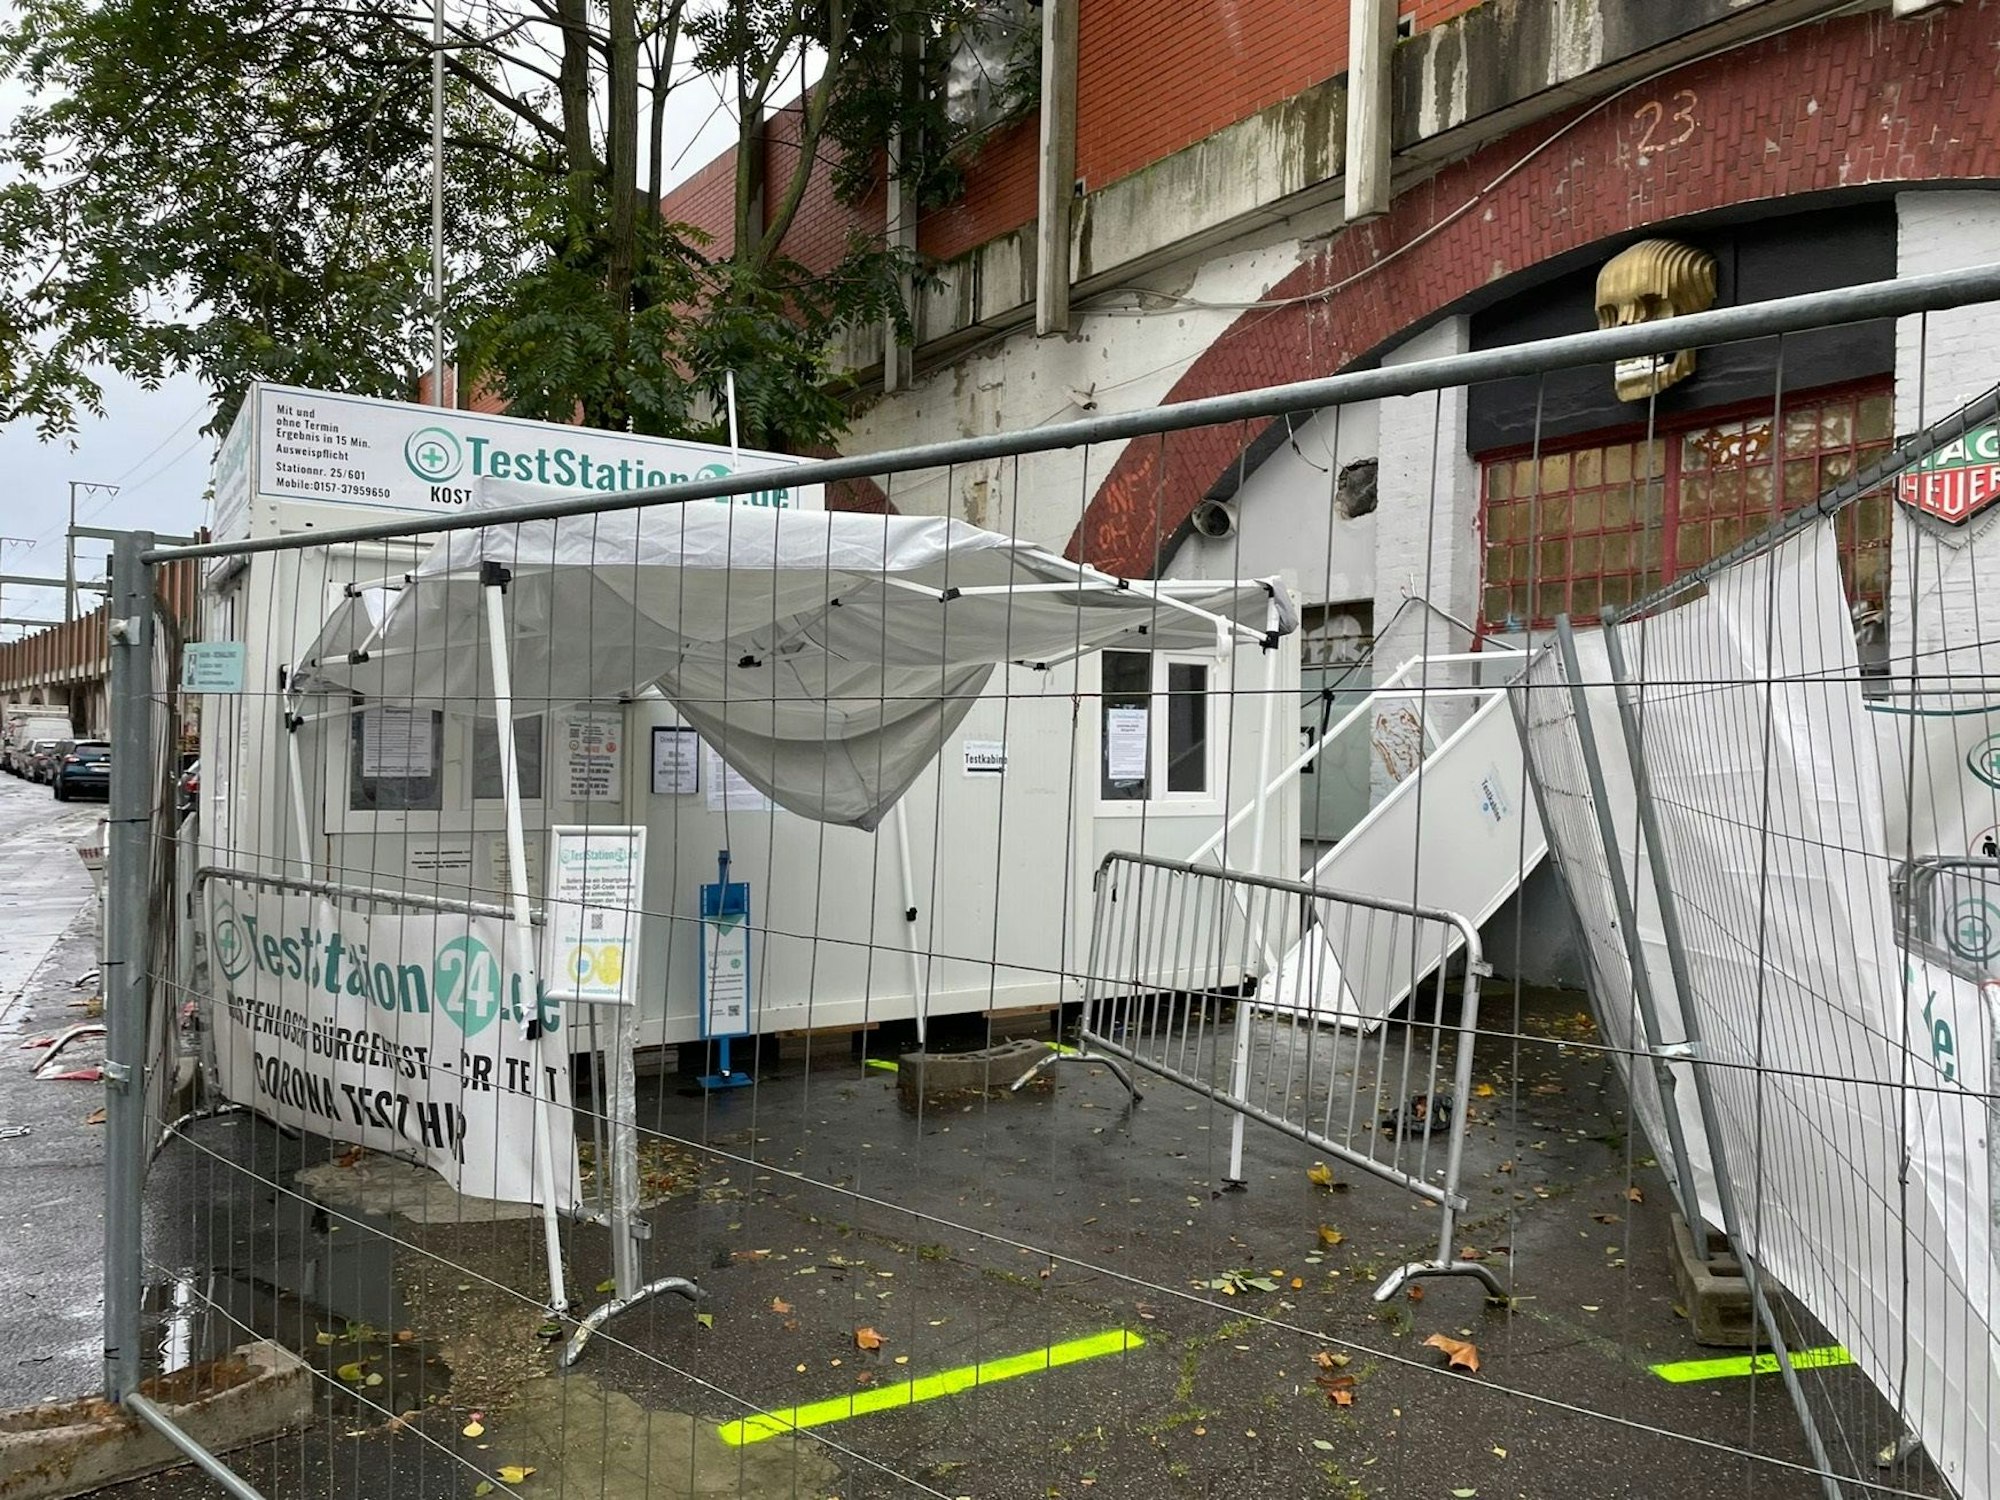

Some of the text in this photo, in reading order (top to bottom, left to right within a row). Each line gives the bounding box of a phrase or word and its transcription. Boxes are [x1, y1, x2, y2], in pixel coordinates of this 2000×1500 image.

[1634, 89, 1698, 152] 23
[276, 404, 315, 419] Mit und
[276, 417, 340, 433] ohne Termin
[276, 428, 371, 449] Ergebnis in 15 Min.
[276, 443, 349, 461] Ausweispflicht
[1920, 429, 2000, 468] AG
[505, 1057, 557, 1103] TET
[254, 1051, 467, 1166] CORONA TEST HIR
